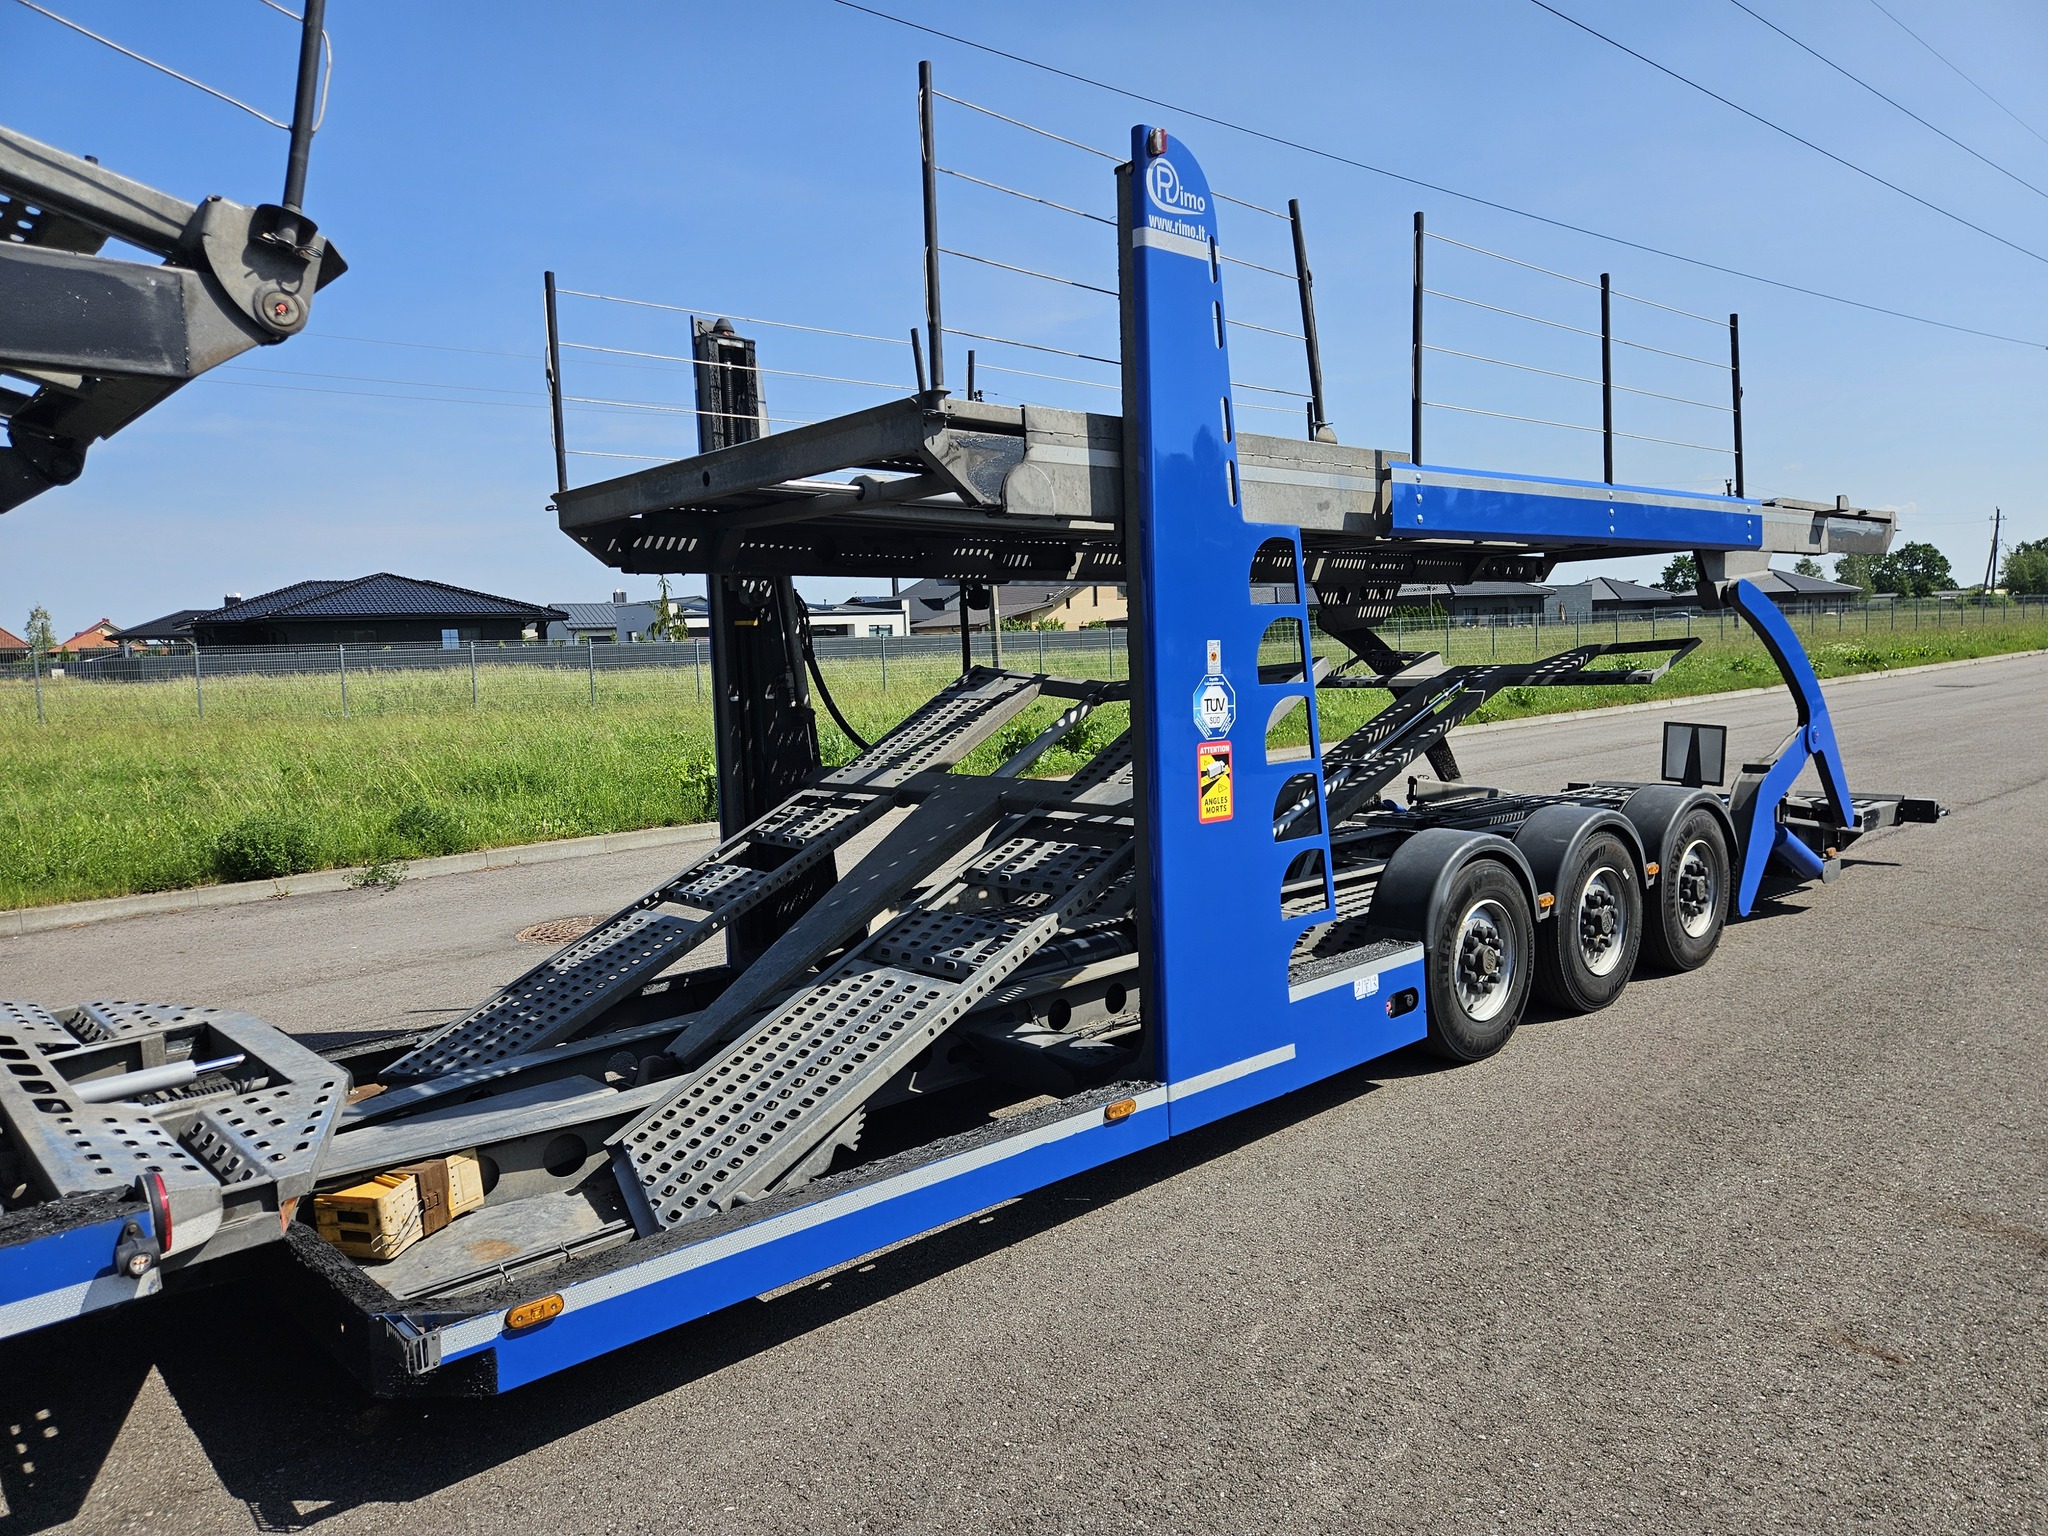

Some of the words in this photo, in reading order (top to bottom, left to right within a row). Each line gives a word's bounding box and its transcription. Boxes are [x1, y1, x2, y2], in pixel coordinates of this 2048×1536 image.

[1147, 159, 1205, 213] Rimo
[1148, 214, 1205, 241] www.rimo.lt
[1204, 697, 1226, 712] TÜV
[1200, 745, 1230, 754] ATTENTION
[1204, 796, 1228, 806] ANGLES
[1205, 805, 1227, 814] MORTS
